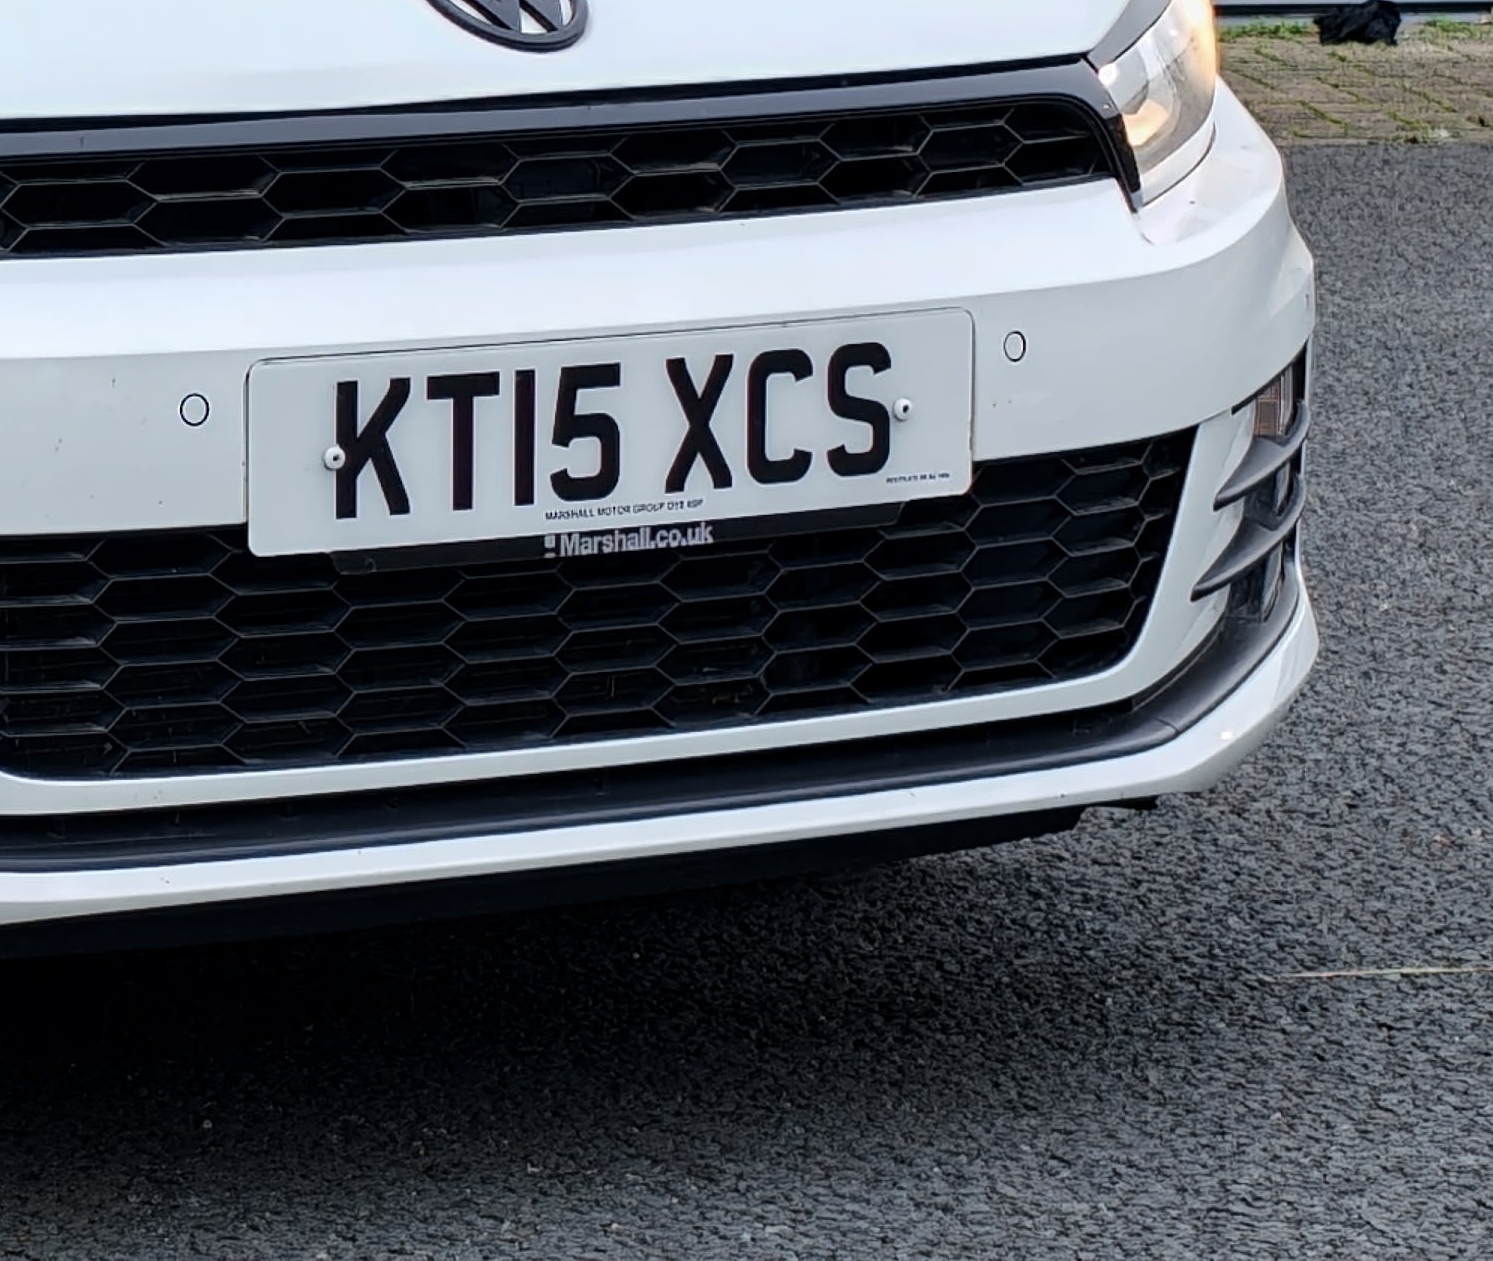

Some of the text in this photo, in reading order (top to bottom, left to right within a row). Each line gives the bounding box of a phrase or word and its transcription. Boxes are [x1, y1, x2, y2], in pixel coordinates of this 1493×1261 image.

[334, 341, 893, 520] KT15 XCS
[545, 508, 595, 521] MARSHALL
[597, 506, 631, 517] MOTOR
[632, 502, 665, 514] GROUP
[559, 521, 714, 558] Marshall.co.uk
